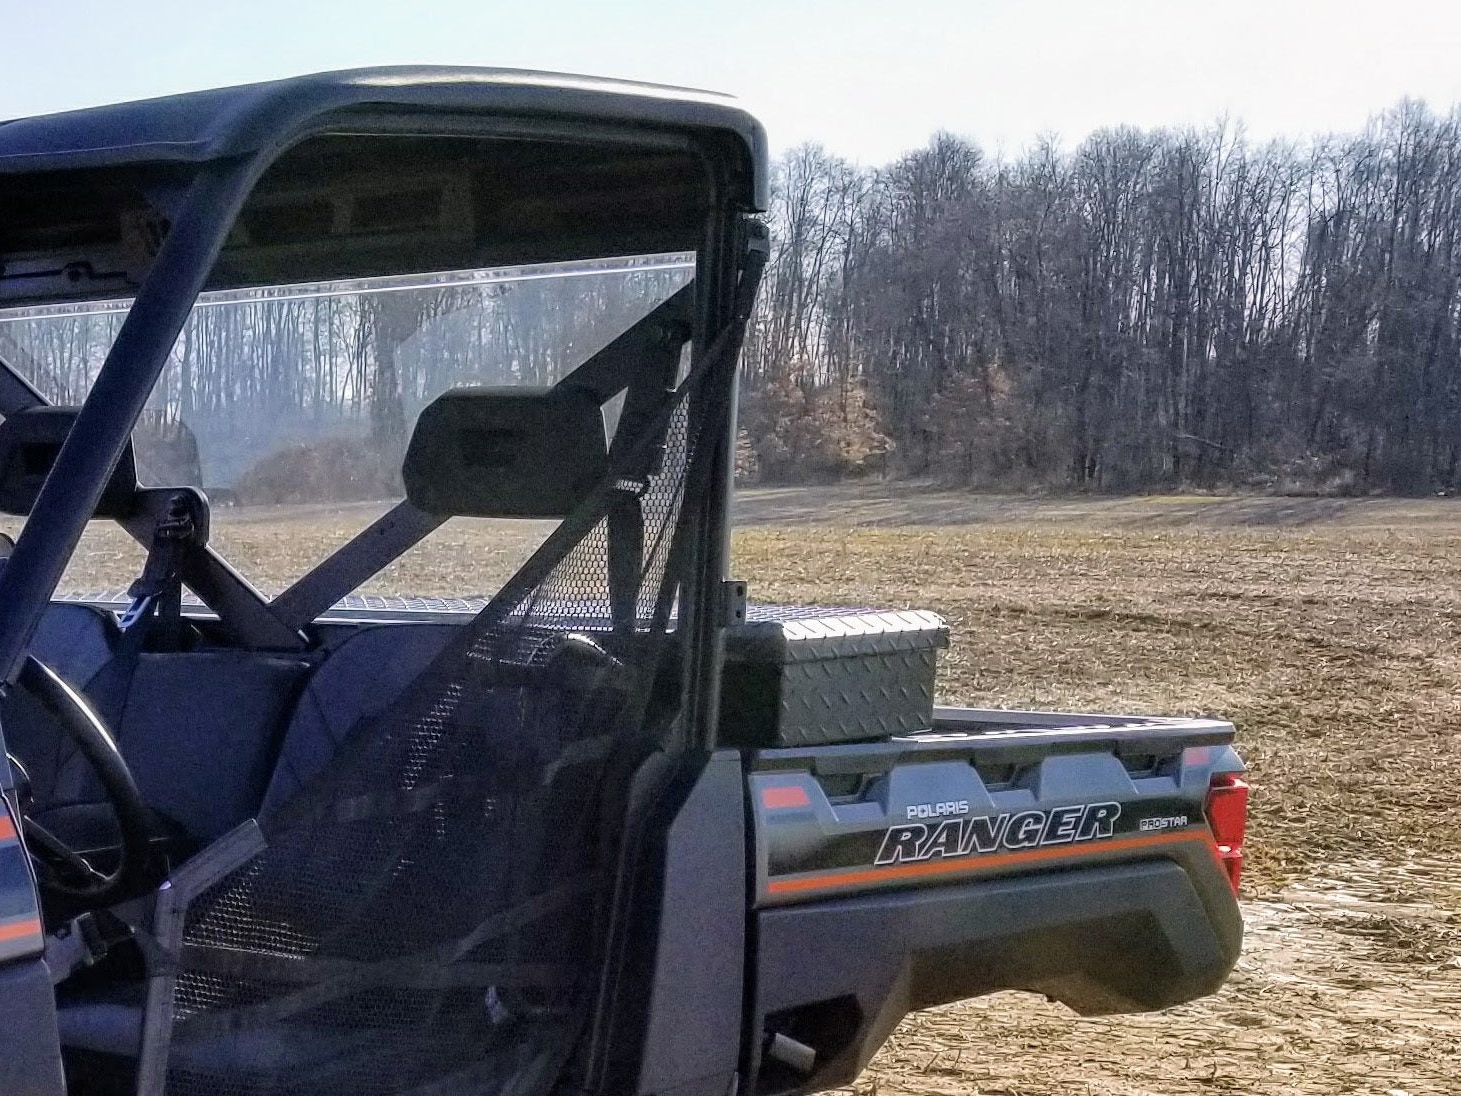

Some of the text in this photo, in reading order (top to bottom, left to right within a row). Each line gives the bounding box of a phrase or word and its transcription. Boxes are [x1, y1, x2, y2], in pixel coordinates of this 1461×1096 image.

[906, 800, 970, 819] POLARIS
[873, 801, 1122, 865] RANGER
[1139, 815, 1188, 832] PROSTAR
